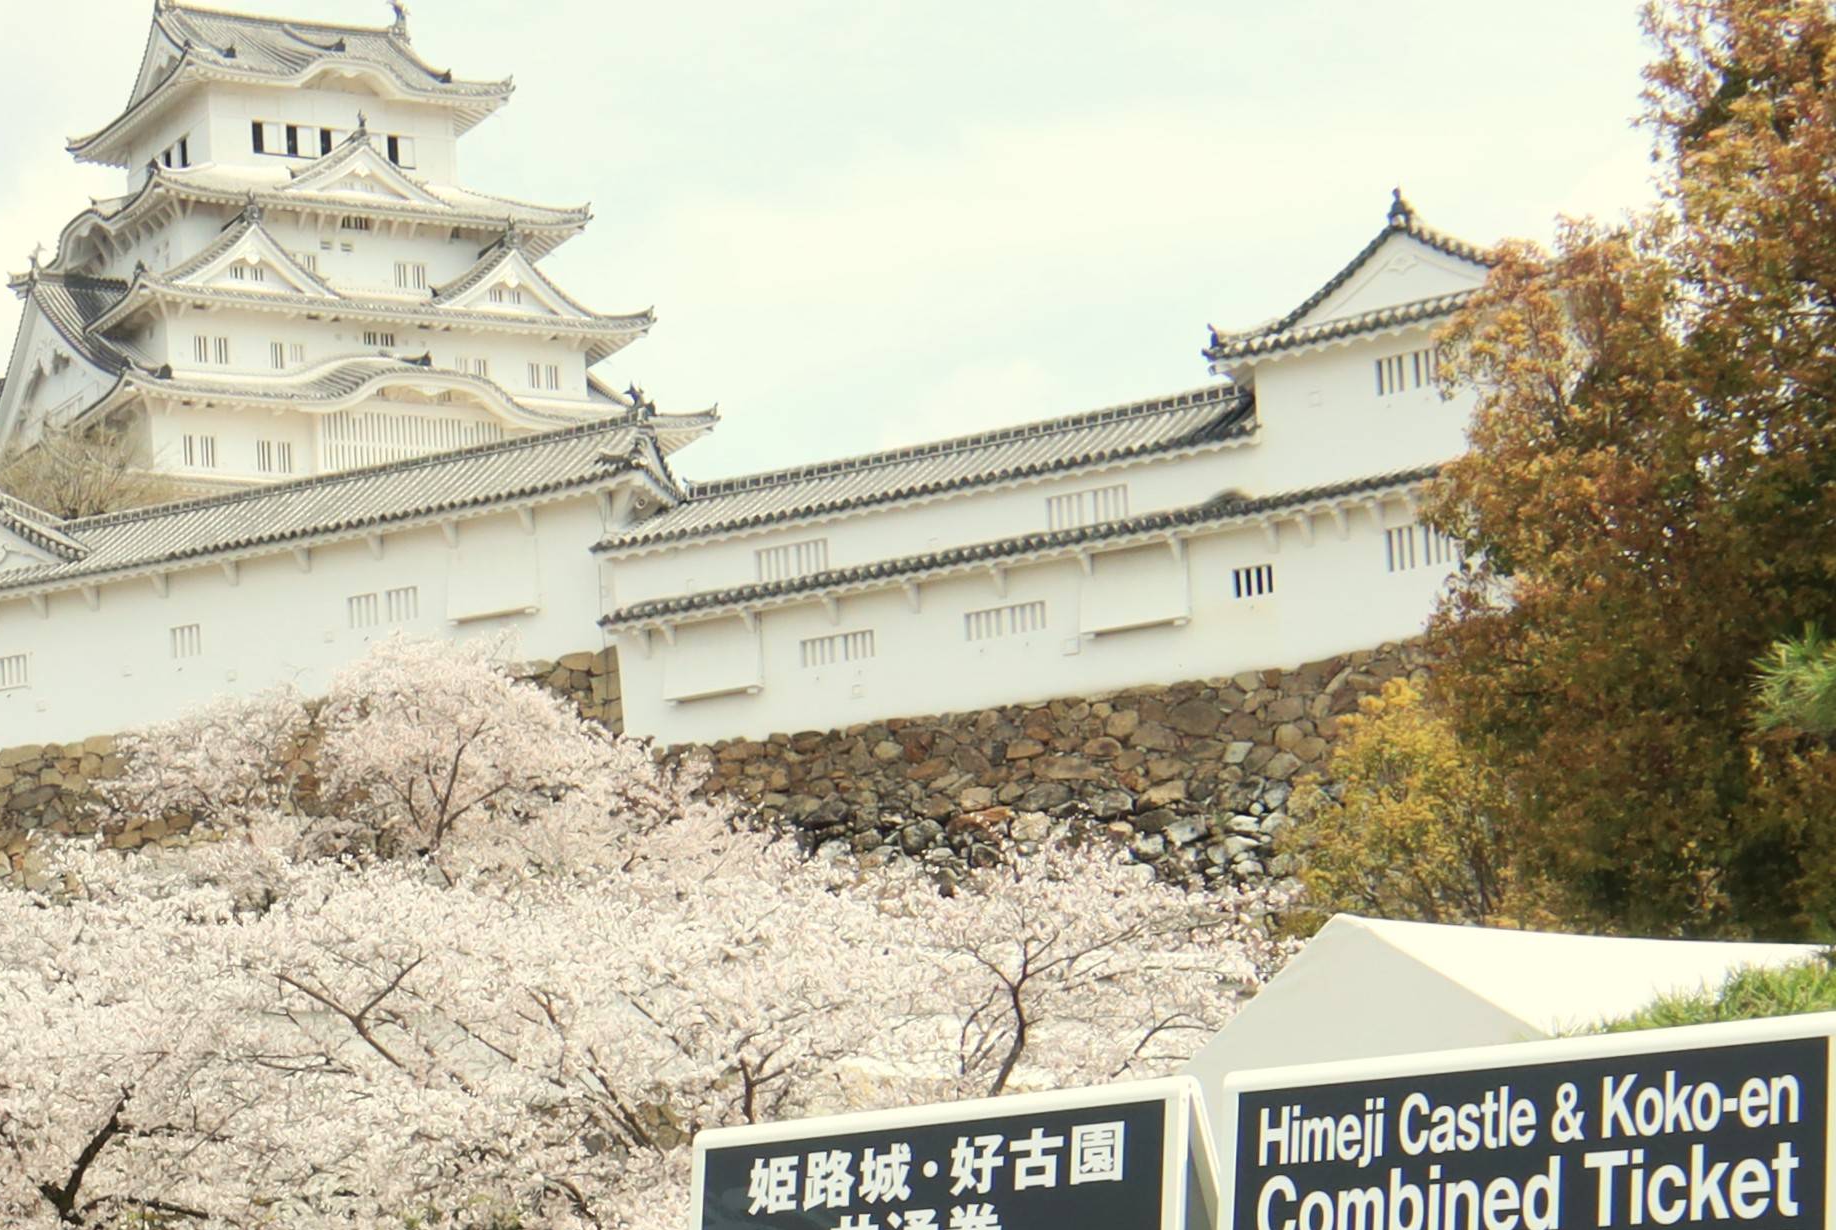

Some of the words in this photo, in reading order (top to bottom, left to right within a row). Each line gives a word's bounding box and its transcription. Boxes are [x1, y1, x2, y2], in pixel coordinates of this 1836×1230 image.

[1258, 1097, 1385, 1168] Himeji
[1399, 1085, 1537, 1157] Castle
[1552, 1081, 1585, 1143] &
[1602, 1070, 1800, 1140] Koko-en
[747, 1120, 1126, 1215] 姫路城・好古園
[1584, 1141, 1800, 1228] Ticket
